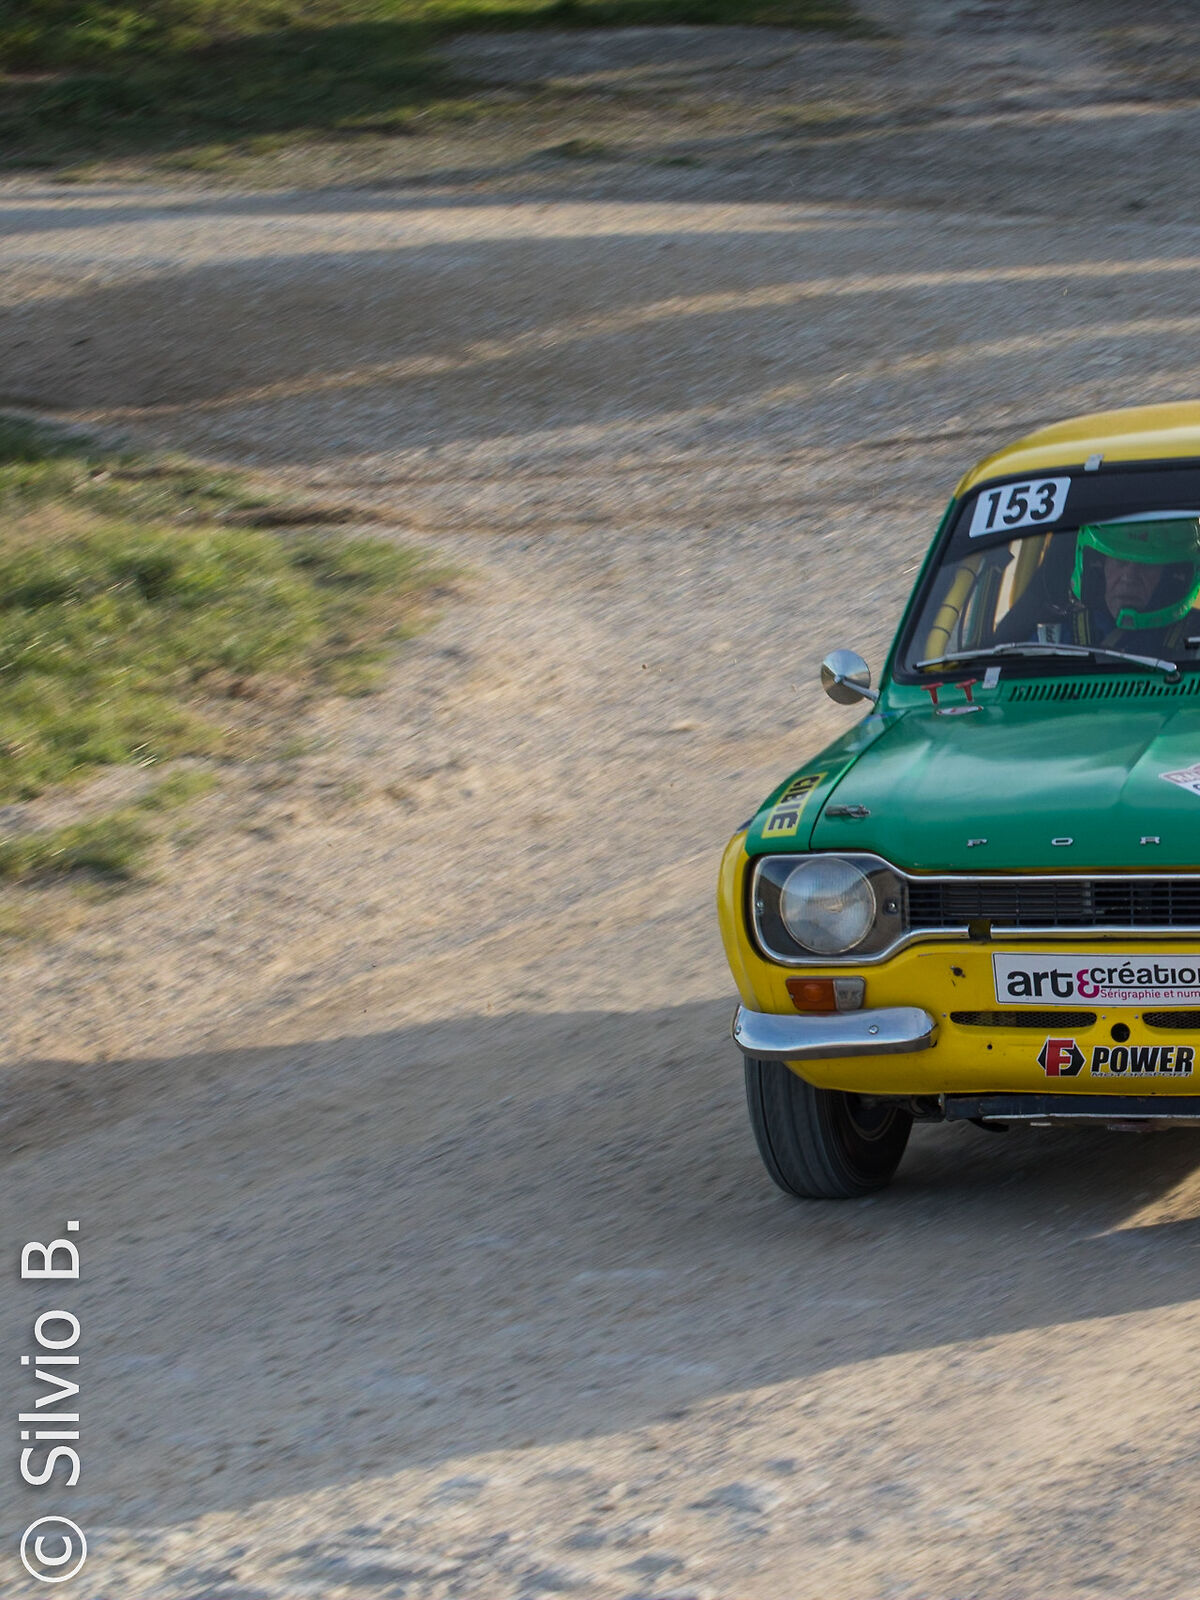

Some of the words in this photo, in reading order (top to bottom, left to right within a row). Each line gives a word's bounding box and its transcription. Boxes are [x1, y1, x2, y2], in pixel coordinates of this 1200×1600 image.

[985, 482, 1057, 529] 153
[1100, 989, 1160, 1000] Sérigraphie
[1163, 989, 1174, 998] et
[1091, 1046, 1195, 1073] POWER
